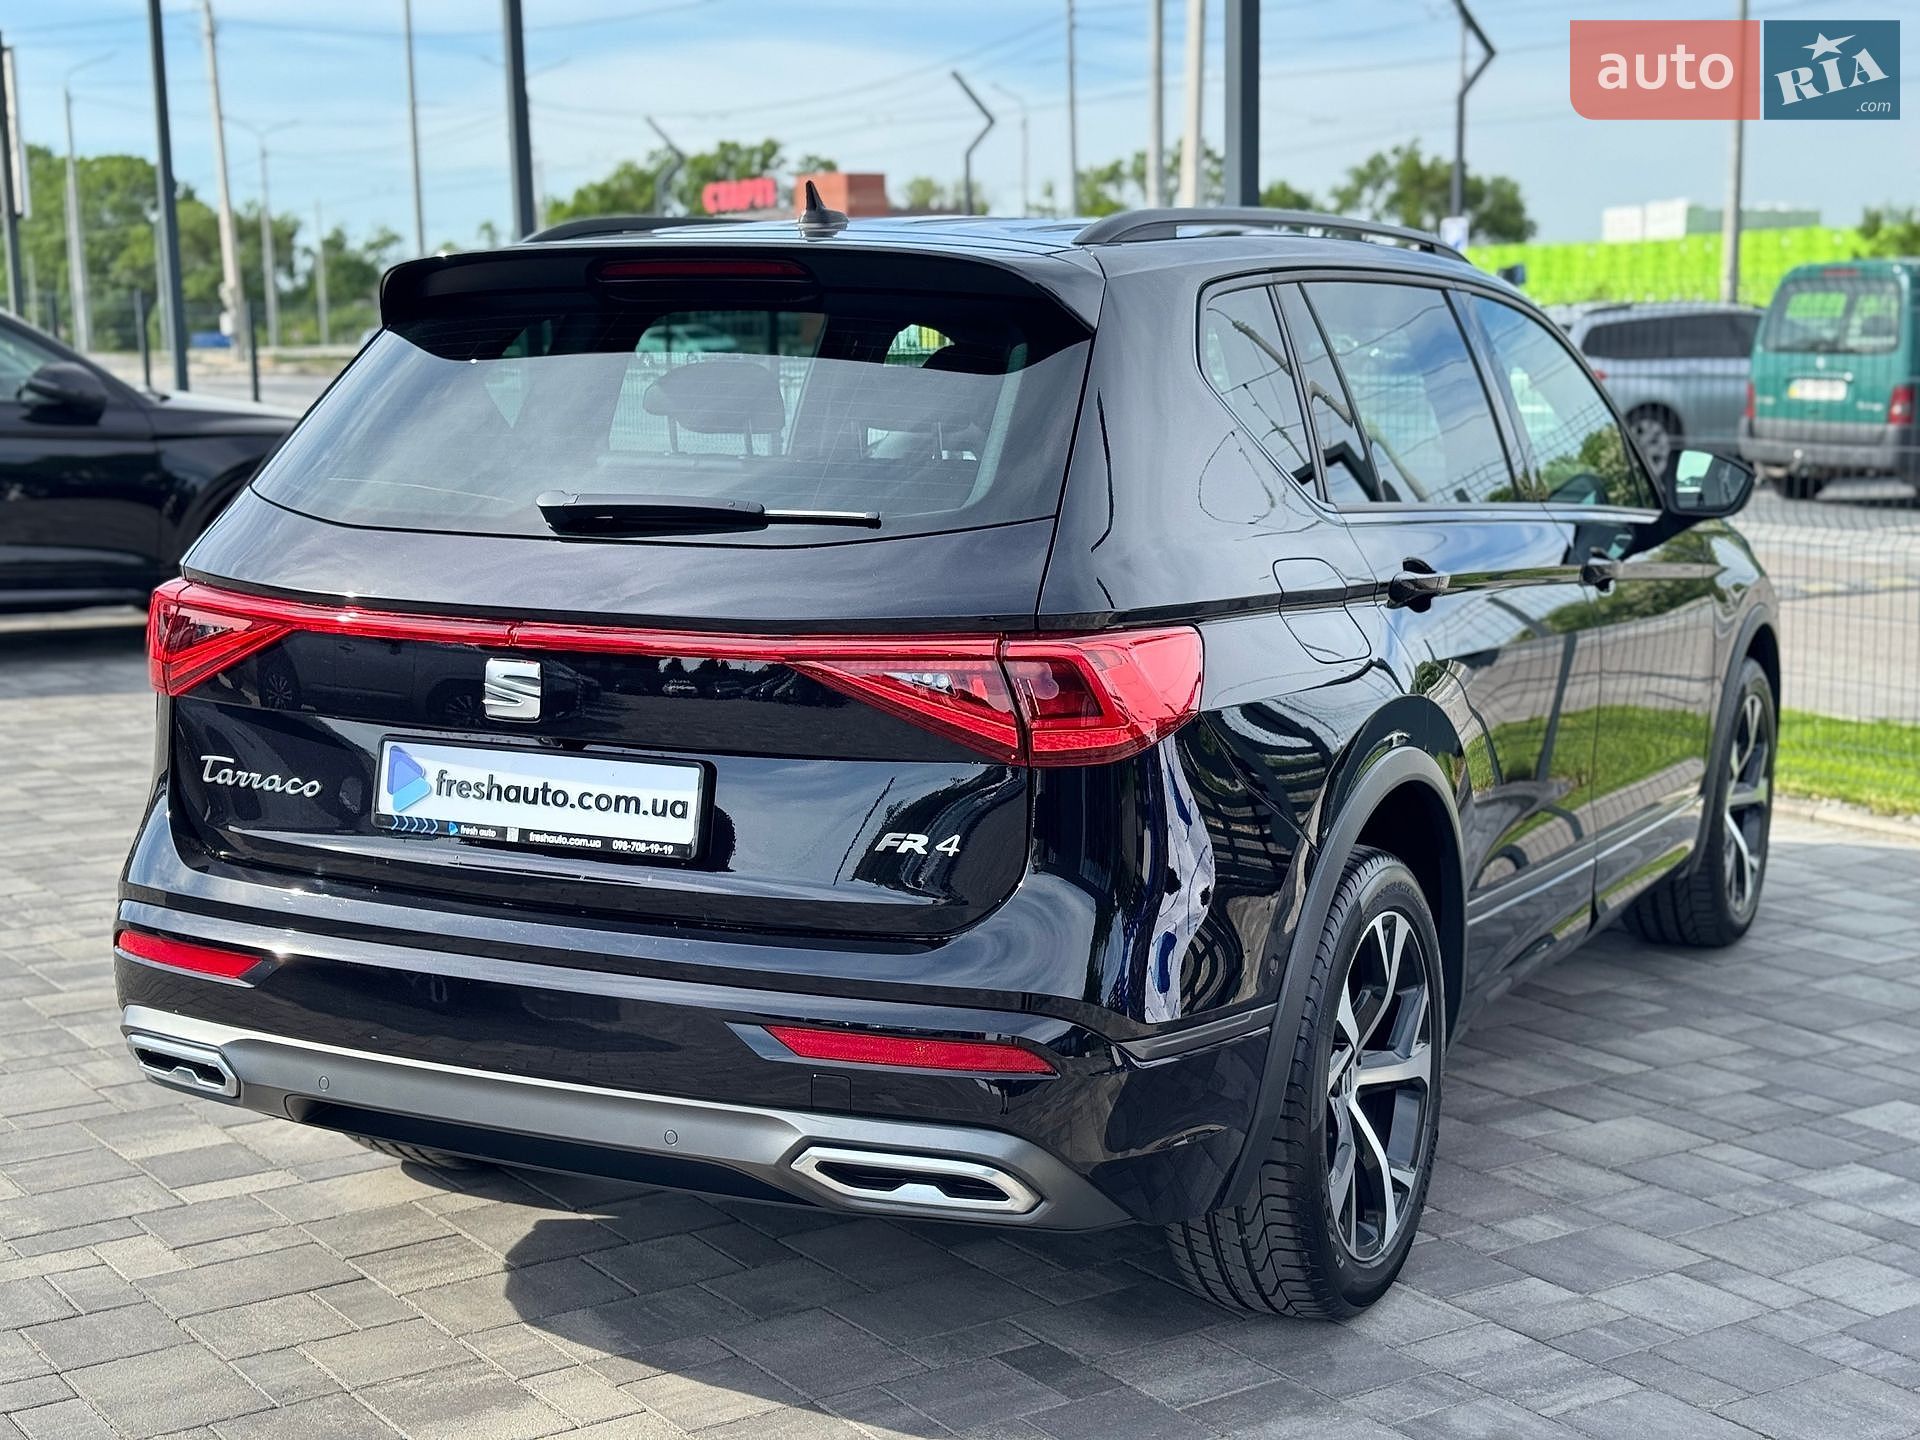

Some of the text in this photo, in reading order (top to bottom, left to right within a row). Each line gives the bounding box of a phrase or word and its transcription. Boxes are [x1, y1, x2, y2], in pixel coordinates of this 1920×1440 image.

[200, 754, 321, 798] Tarraco
[435, 768, 690, 819] freshauto.com.ua
[460, 824, 497, 838] fresh auto
[529, 831, 602, 849] freshauto.com.ua
[874, 832, 961, 857] FR 4
